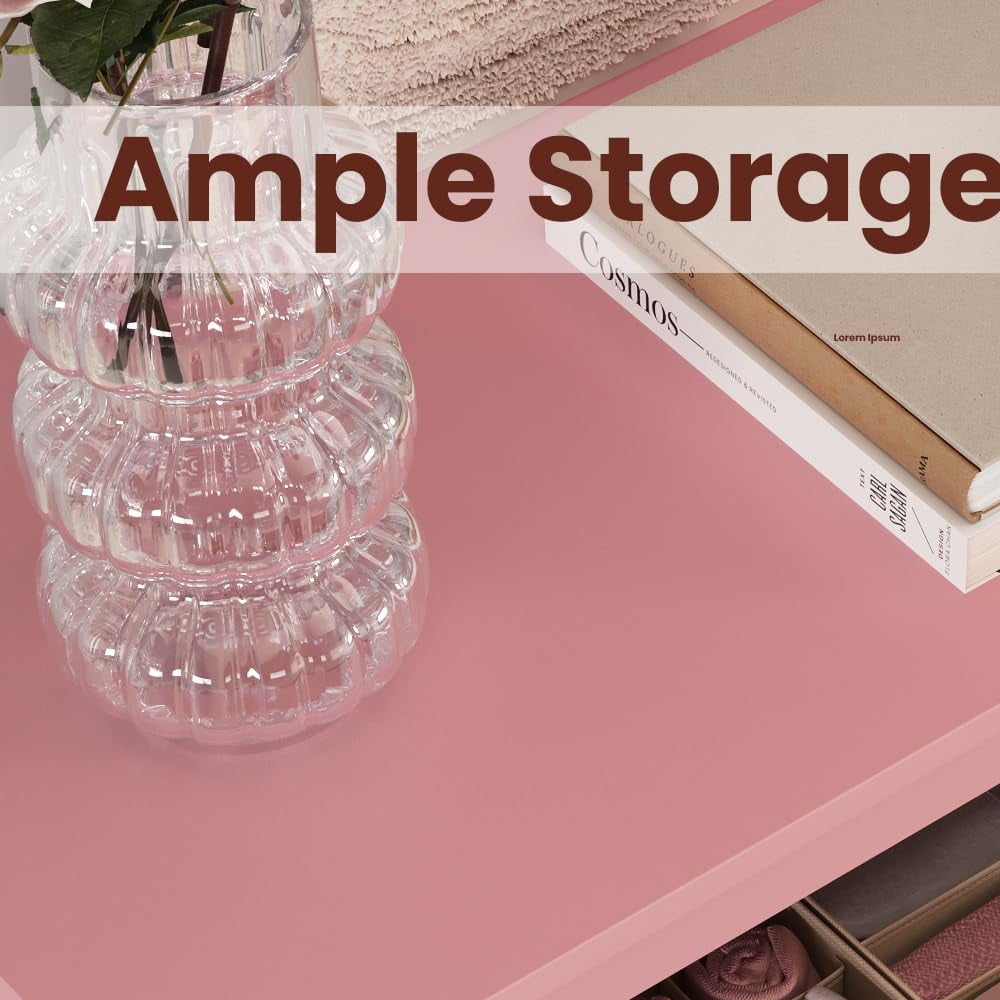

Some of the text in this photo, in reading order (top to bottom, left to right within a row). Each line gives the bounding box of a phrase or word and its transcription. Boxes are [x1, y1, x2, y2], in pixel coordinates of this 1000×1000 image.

[579, 230, 680, 337] Cosmos
[869, 474, 888, 512] CARL
[889, 483, 907, 533] SAGAN
